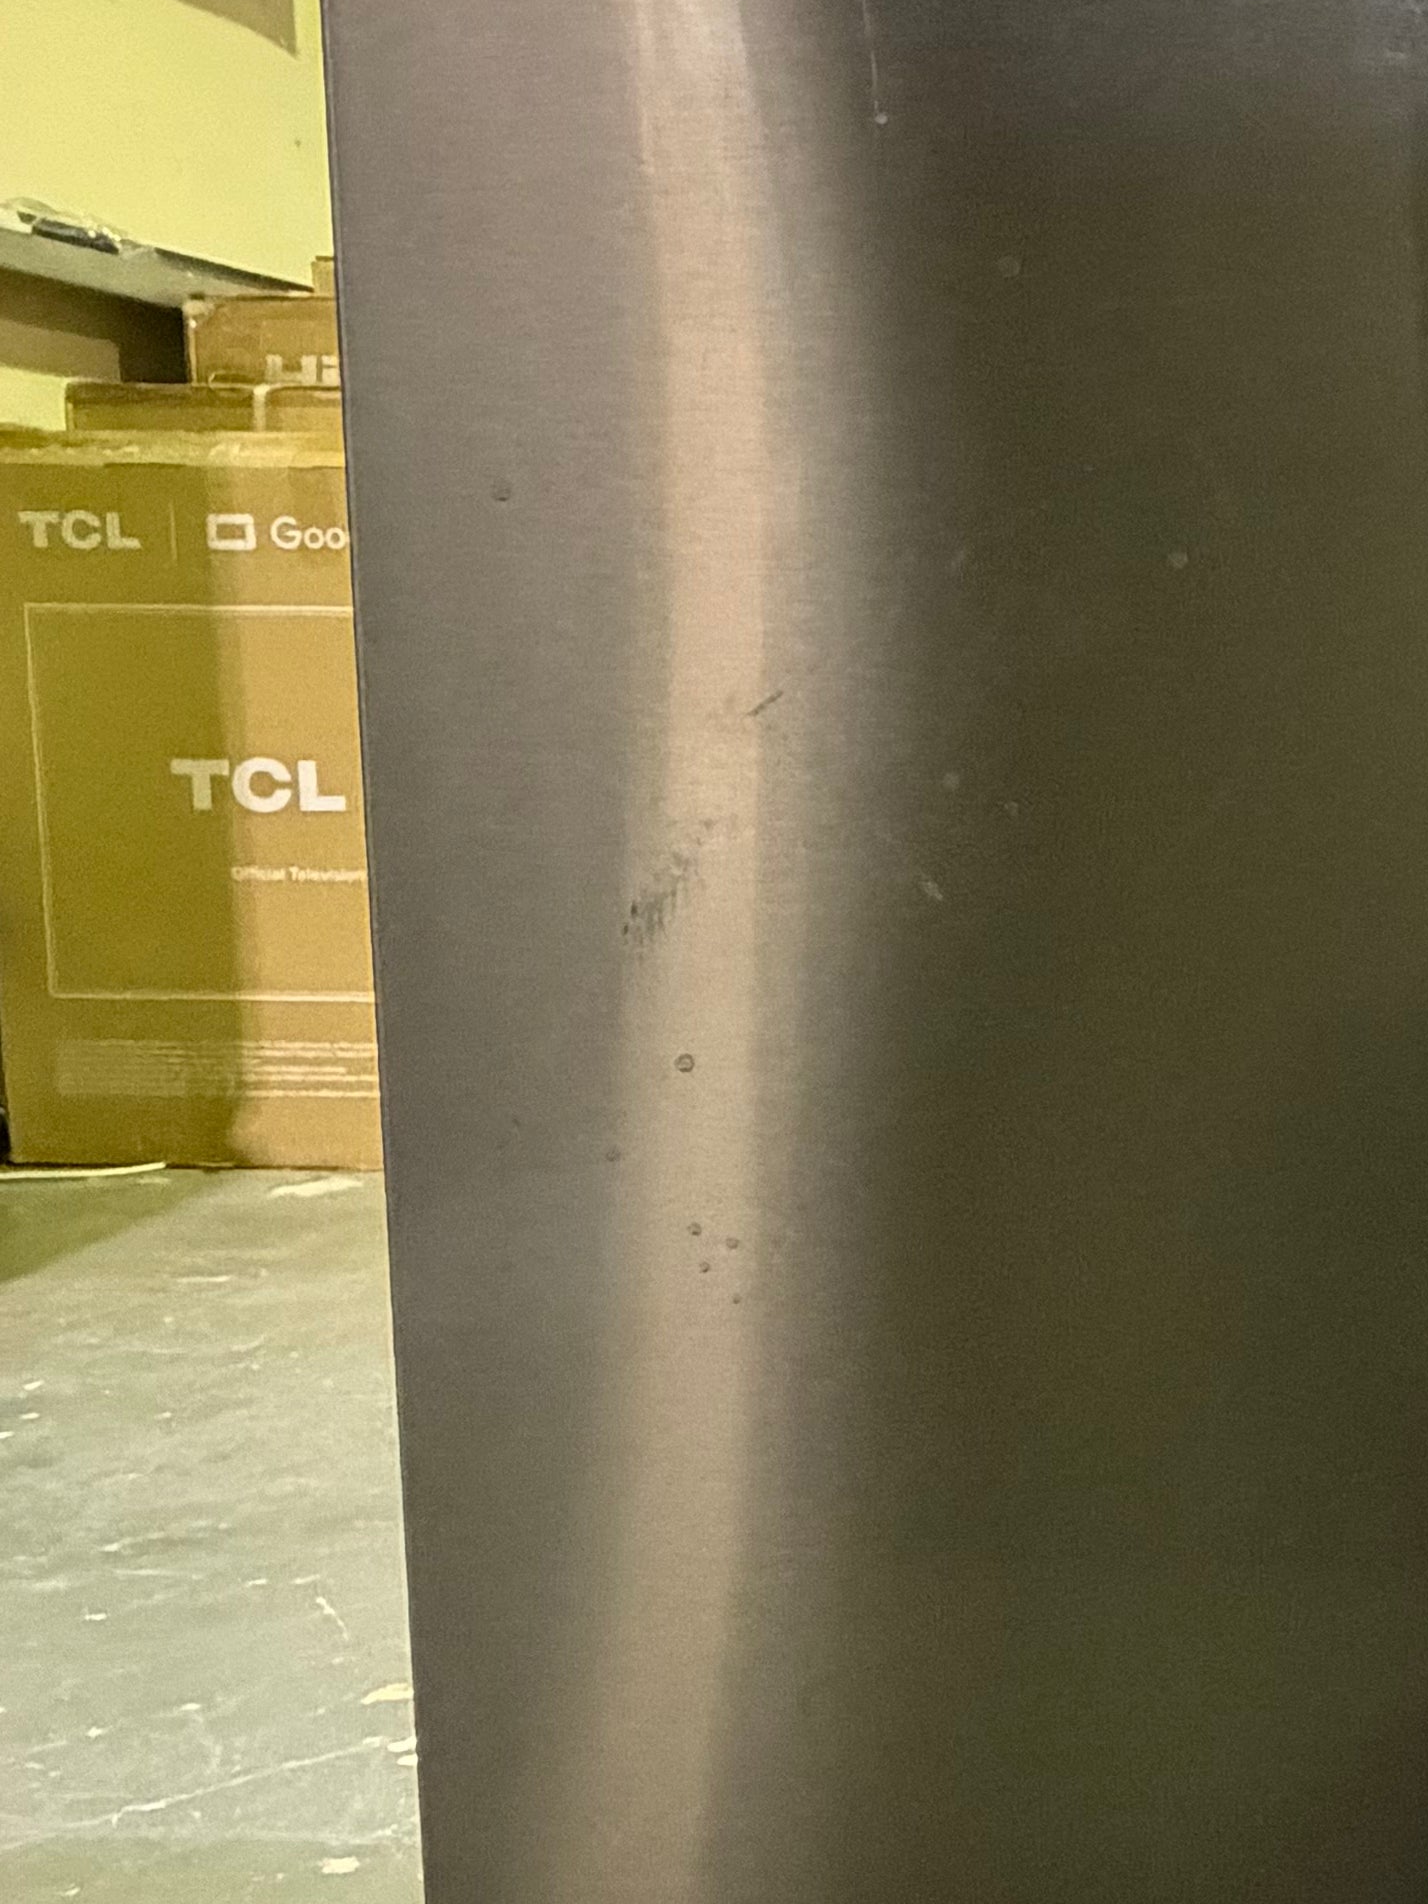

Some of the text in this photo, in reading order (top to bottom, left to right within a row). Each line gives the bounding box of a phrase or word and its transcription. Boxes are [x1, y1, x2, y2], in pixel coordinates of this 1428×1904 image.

[17, 509, 348, 550] TCL Goo
[170, 756, 347, 814] TCL
